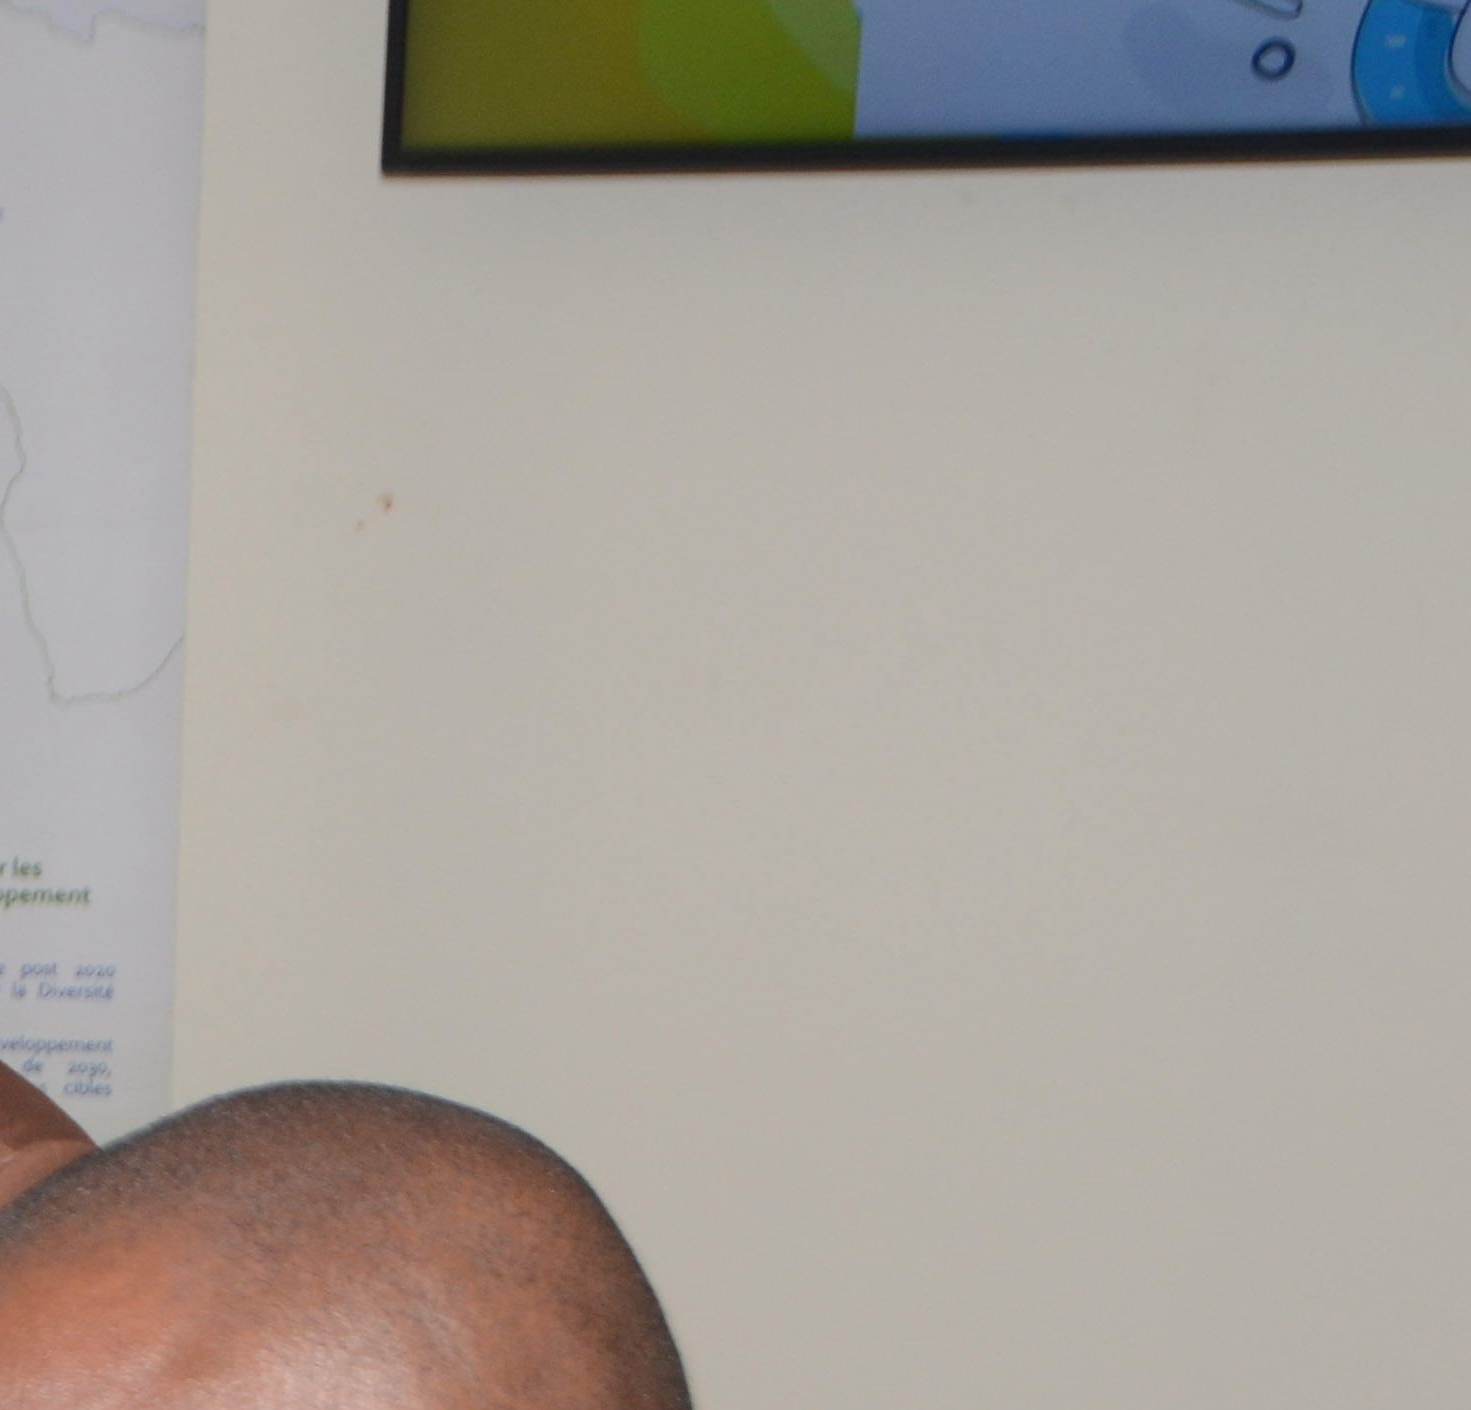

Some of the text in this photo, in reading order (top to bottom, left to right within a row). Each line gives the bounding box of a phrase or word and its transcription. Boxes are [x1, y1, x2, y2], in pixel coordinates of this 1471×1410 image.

[12, 858, 42, 879] les
[21, 961, 59, 979] post
[75, 963, 117, 978] 2020
[12, 981, 26, 997] la
[37, 981, 116, 999] Diversité
[22, 1056, 44, 1072] de
[63, 1078, 113, 1096] cibles
